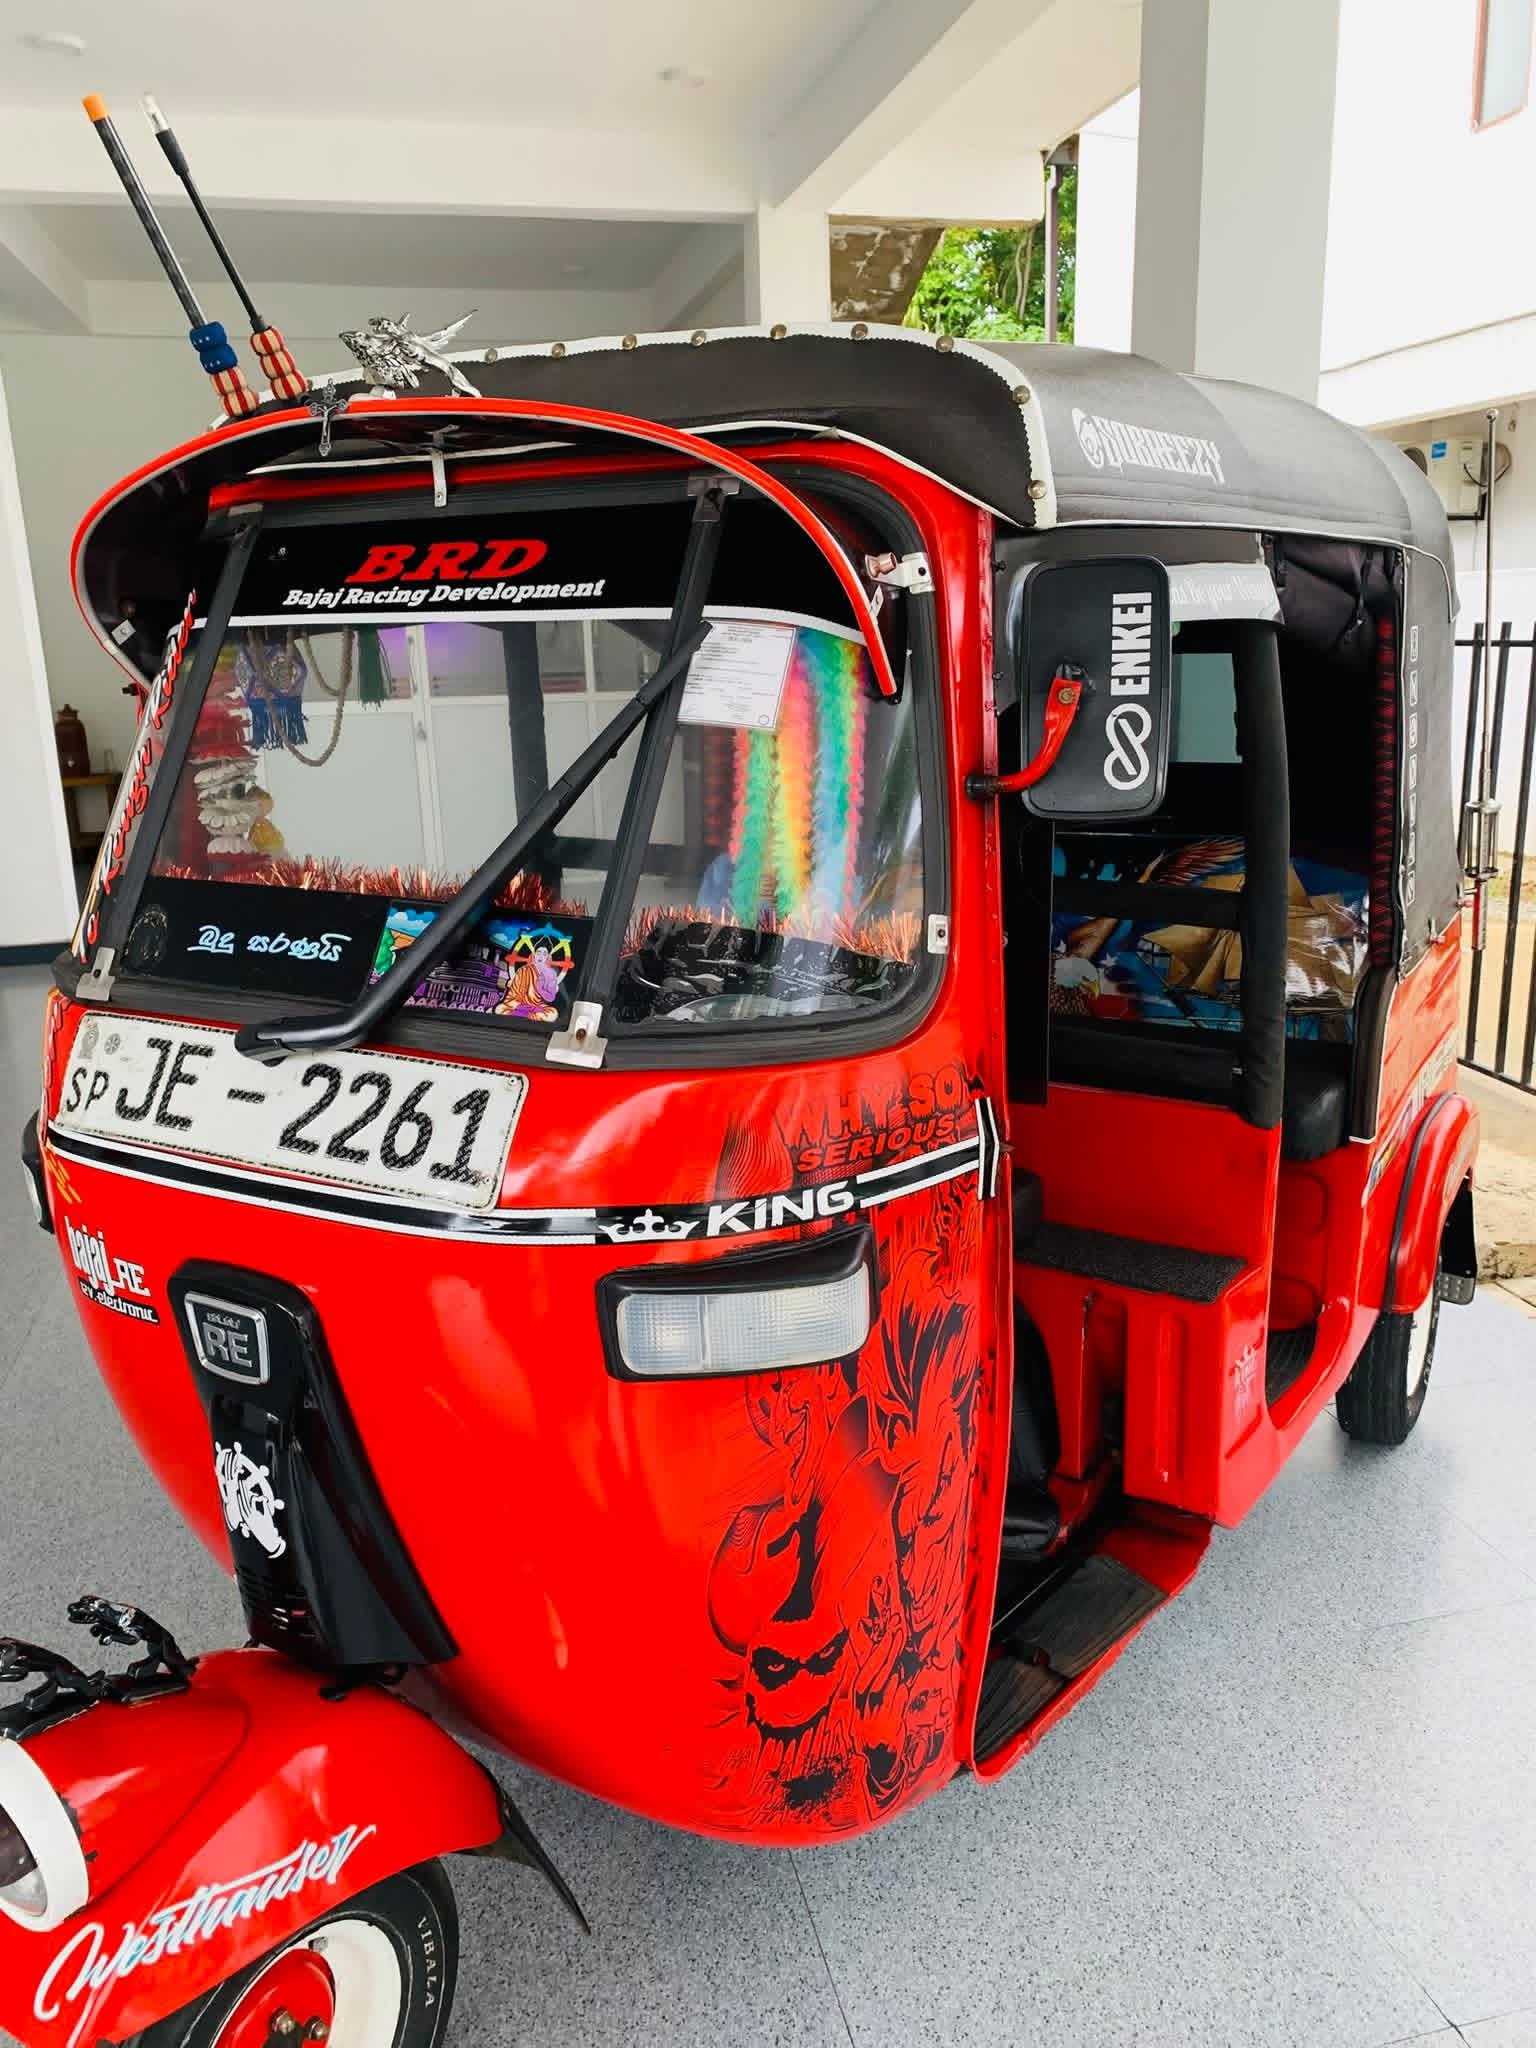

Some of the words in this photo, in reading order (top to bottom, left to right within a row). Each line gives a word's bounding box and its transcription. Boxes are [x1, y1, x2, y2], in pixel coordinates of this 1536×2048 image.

[344, 539, 548, 583] BRD
[282, 588, 343, 609] Bajaj
[342, 585, 425, 607] Racing
[427, 579, 606, 604] Development
[1110, 592, 1152, 696] ENKEI
[65, 1067, 110, 1113] SP
[115, 1037, 215, 1131] JE
[276, 1062, 492, 1186] 2261
[907, 1063, 964, 1120] SO
[796, 1112, 956, 1173] SERIOUS
[706, 1181, 853, 1237] KING
[201, 1322, 253, 1369] RE
[417, 1916, 438, 2008] VIBALA
